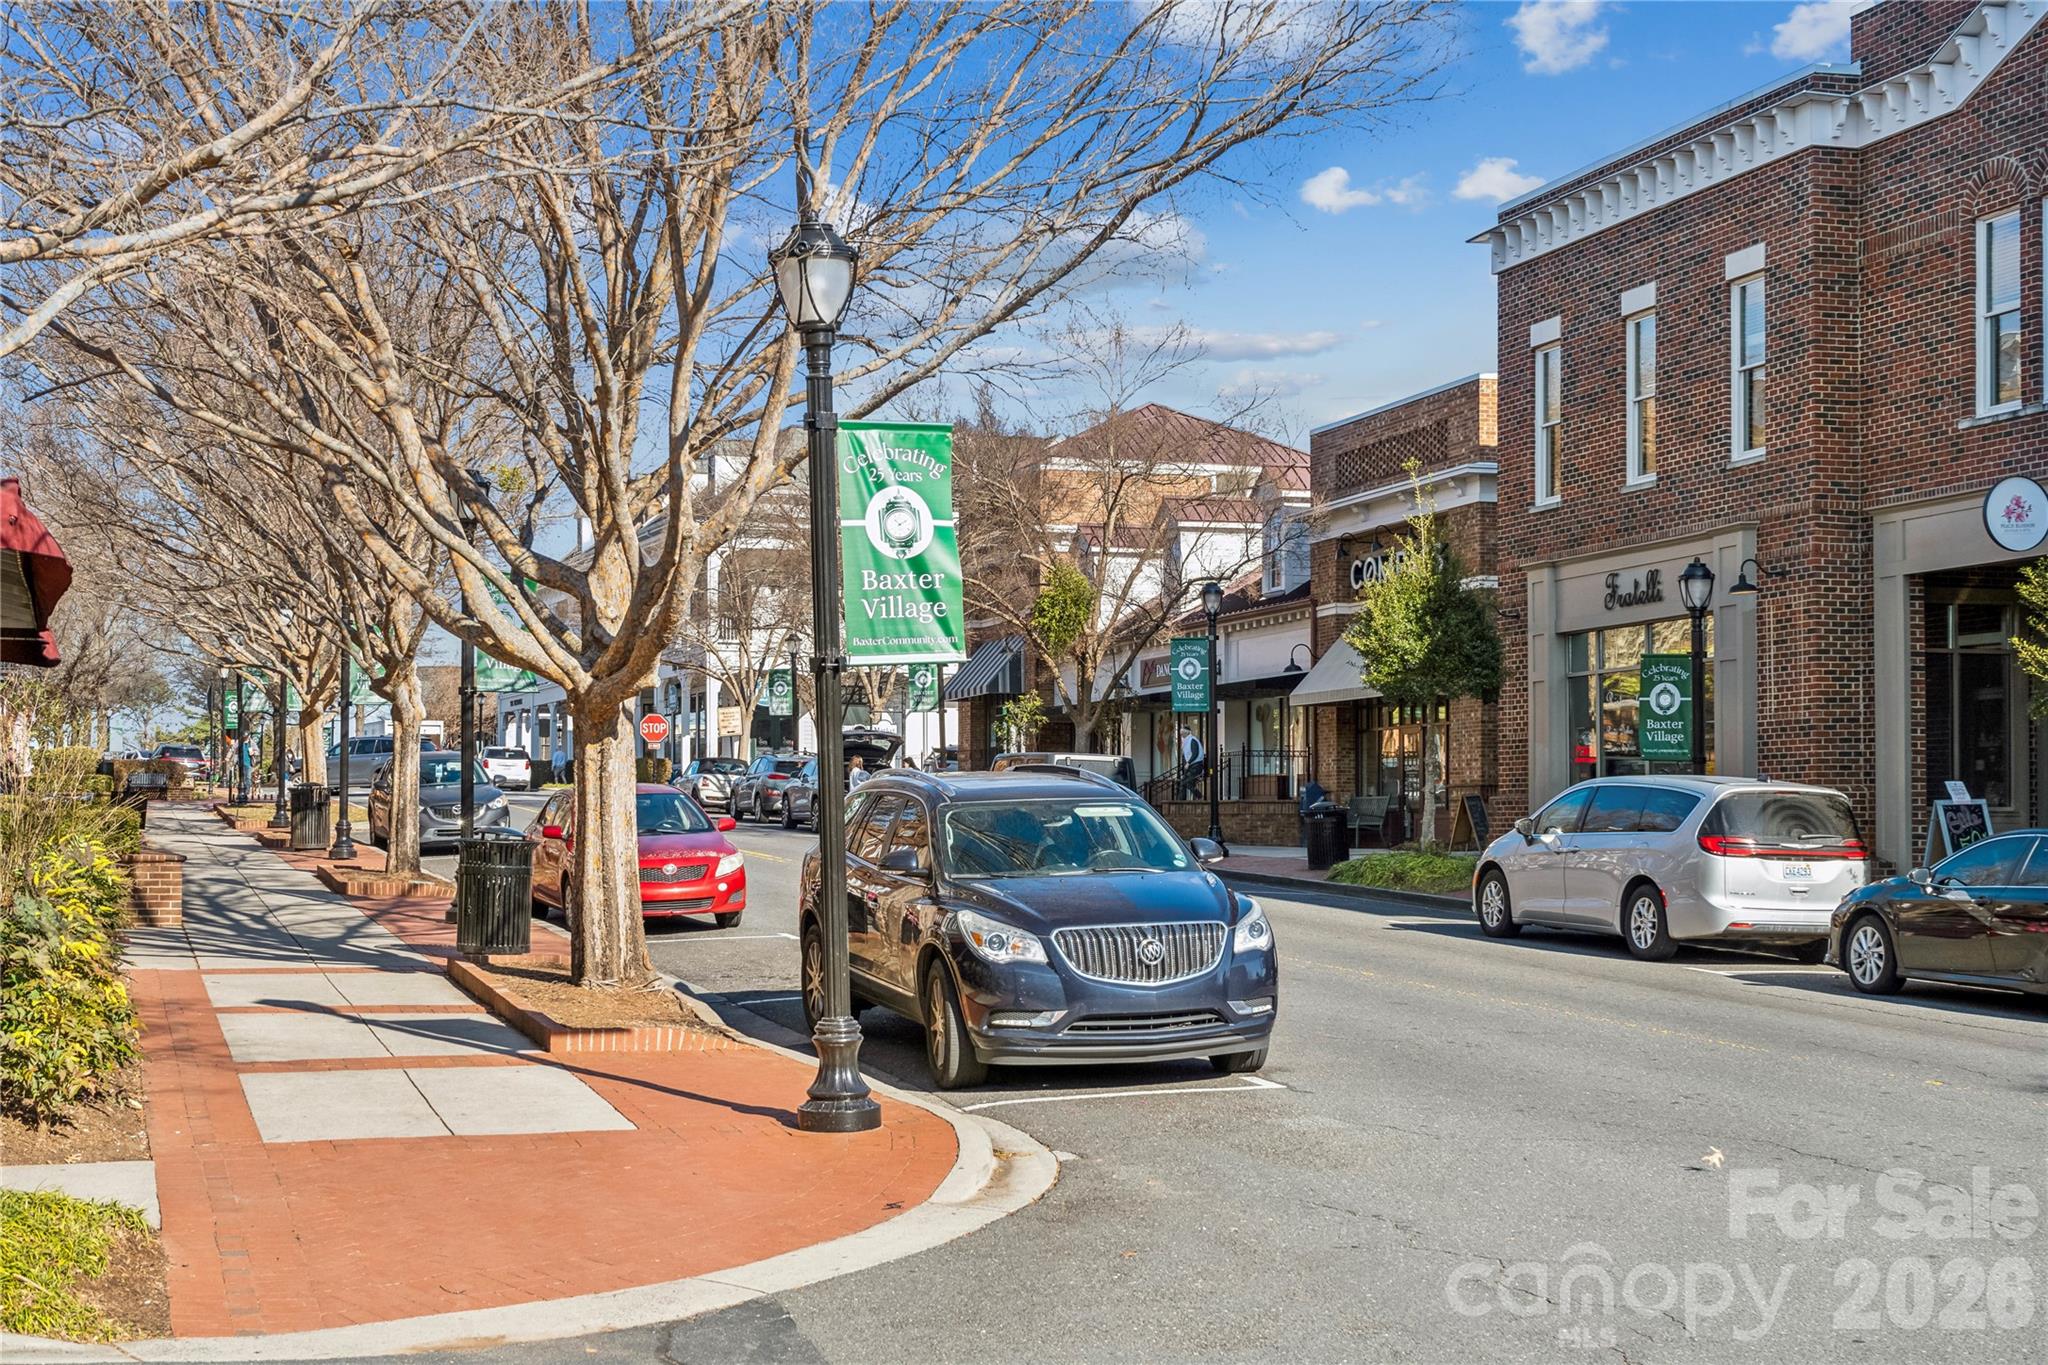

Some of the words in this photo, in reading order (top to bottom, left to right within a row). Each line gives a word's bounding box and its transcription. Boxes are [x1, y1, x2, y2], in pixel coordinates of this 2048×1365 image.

[843, 442, 948, 480] Celebrating
[868, 468, 885, 484] 25
[889, 469, 923, 482] Years
[861, 569, 945, 590] Baxter
[1604, 568, 1664, 610] Fratelli
[861, 595, 948, 624] Village
[853, 635, 959, 647] BaxterCommunity.com
[1641, 664, 1690, 680] Celebrating
[1177, 690, 1205, 701] Village
[642, 723, 667, 734] STOP
[1647, 719, 1684, 729] Baxter
[1646, 731, 1684, 744] Village
